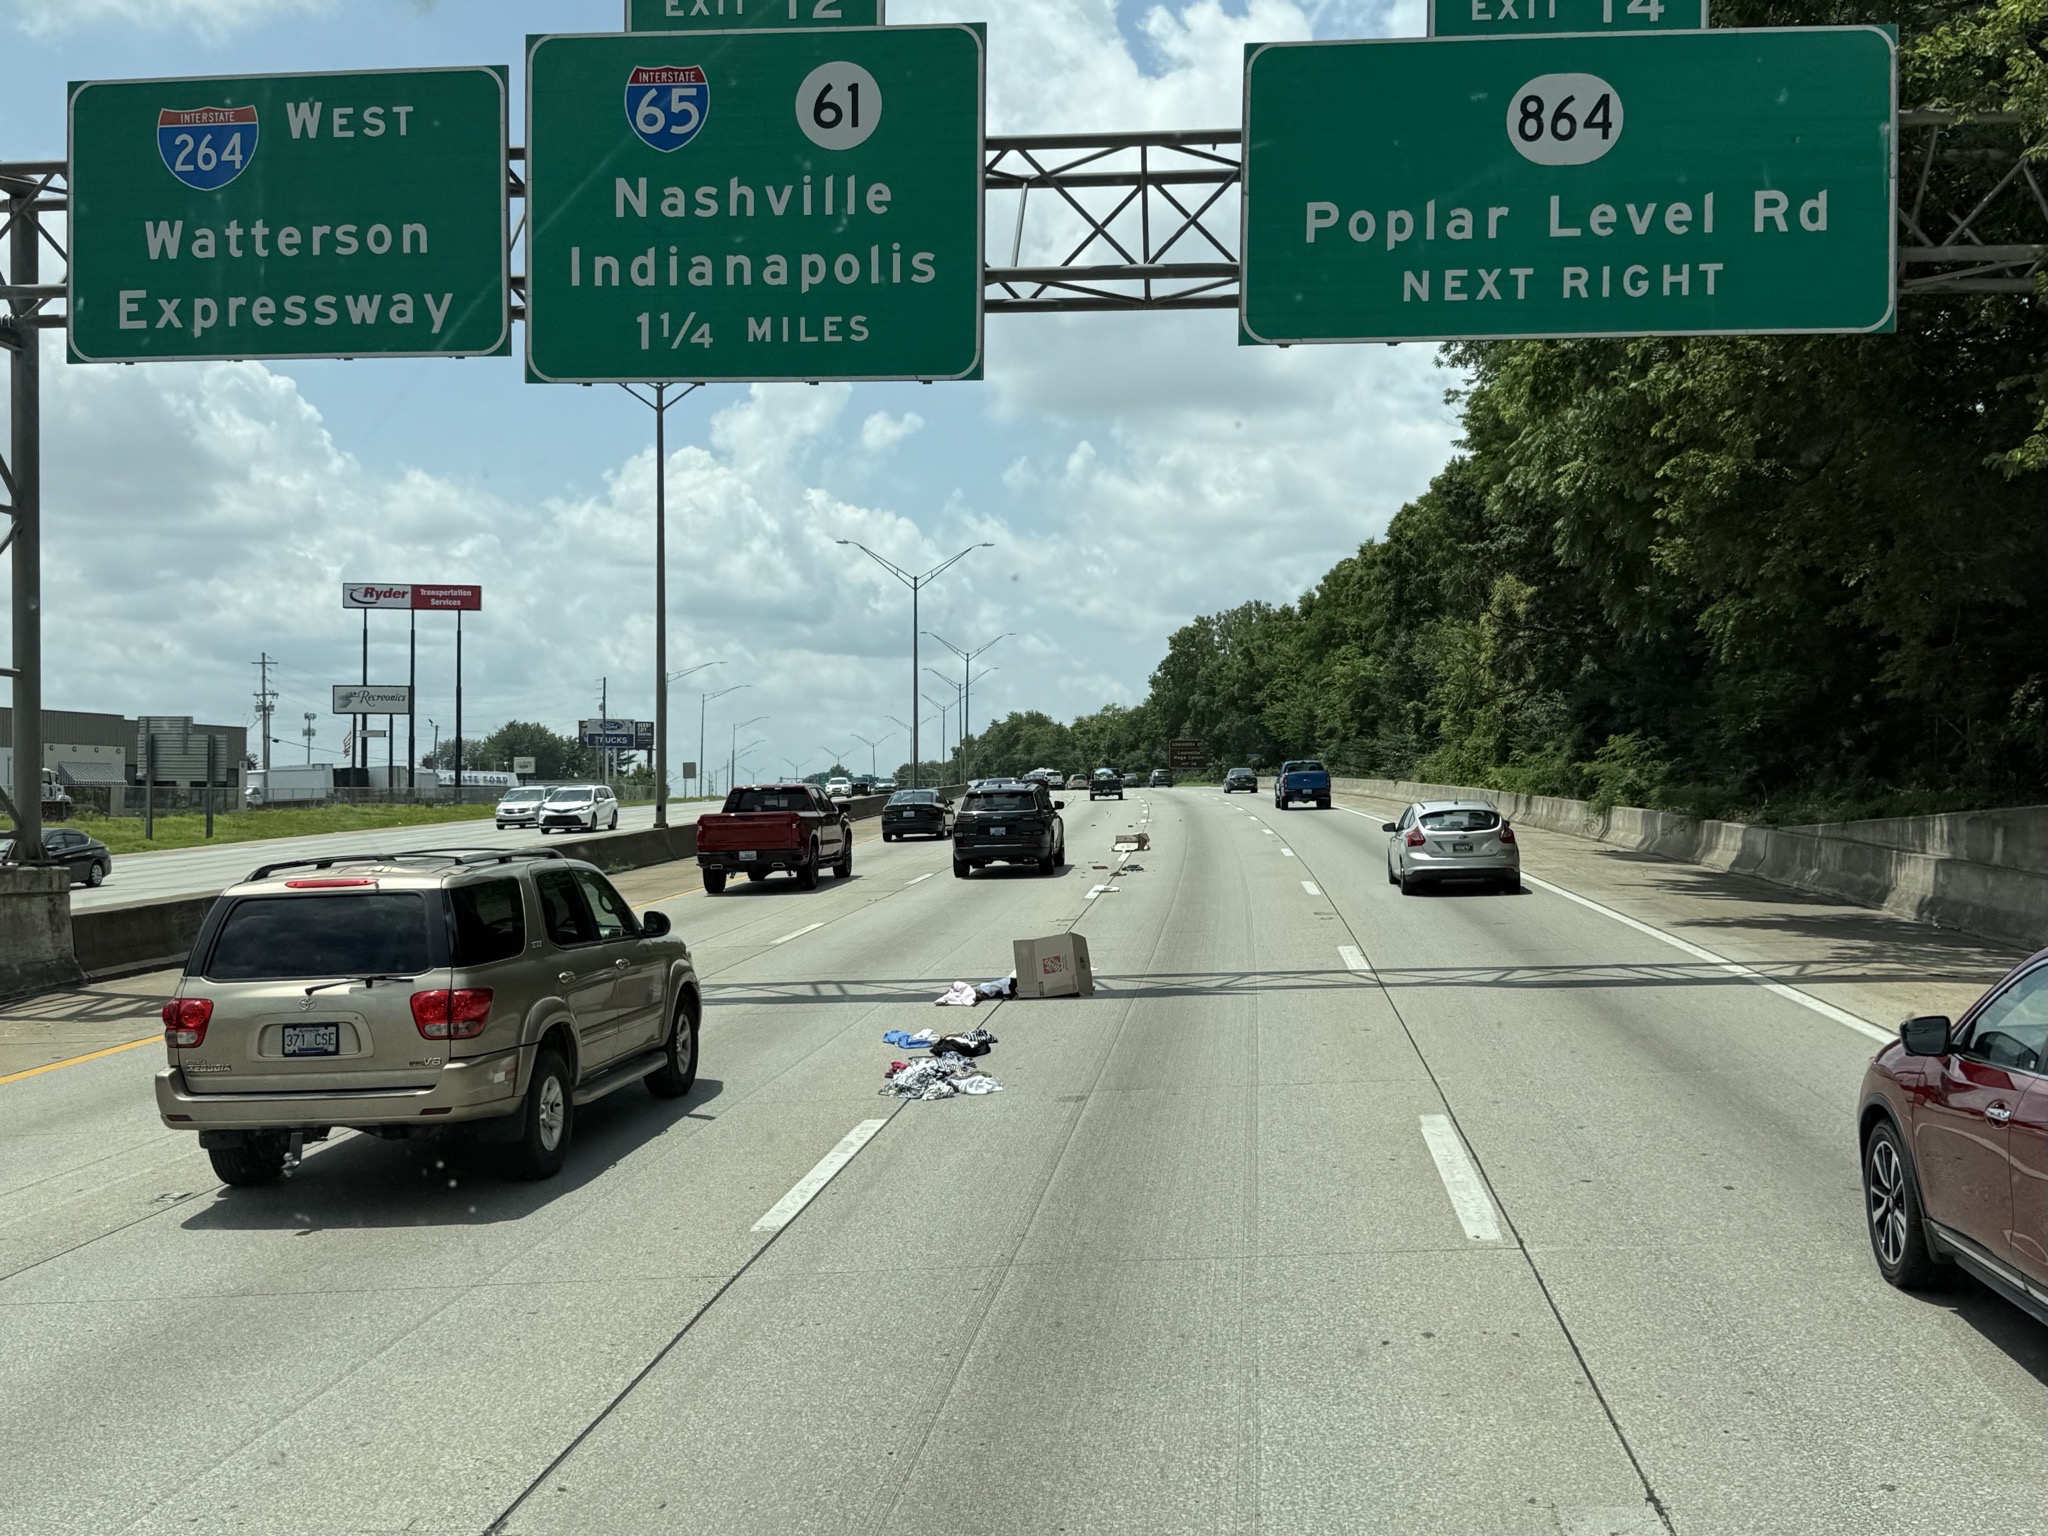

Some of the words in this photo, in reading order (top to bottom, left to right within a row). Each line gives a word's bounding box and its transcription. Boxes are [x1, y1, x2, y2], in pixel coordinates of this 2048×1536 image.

[665, 0, 744, 17] EXIT
[788, 0, 842, 19] 12
[1471, 0, 1556, 20] EXIT
[1603, 0, 1665, 23] 14
[637, 70, 697, 84] INTERSTATE
[180, 110, 235, 124] INTERSTATE
[286, 102, 415, 140] WEST
[635, 87, 701, 135] 65
[812, 82, 860, 129] 61
[1517, 93, 1614, 143] 864
[174, 132, 244, 173] 264
[615, 175, 893, 218] Nashville
[1306, 198, 1510, 251] Poplar
[1549, 191, 1715, 238] Level
[1754, 188, 1830, 234] Rd
[145, 219, 429, 260] Watterson
[570, 242, 937, 293] Indianapolis
[1402, 267, 1536, 303] NEXT
[1563, 263, 1726, 299] RIGHT
[118, 289, 454, 339] Expressway
[747, 315, 870, 343] MILES
[363, 587, 409, 600] Ryder
[420, 588, 472, 597] Transportation
[430, 598, 461, 606] Services
[595, 736, 628, 744] TUCKS
[286, 1033, 306, 1047] 371
[314, 1032, 335, 1046] CSE
[186, 1064, 232, 1073] SEQUOIA
